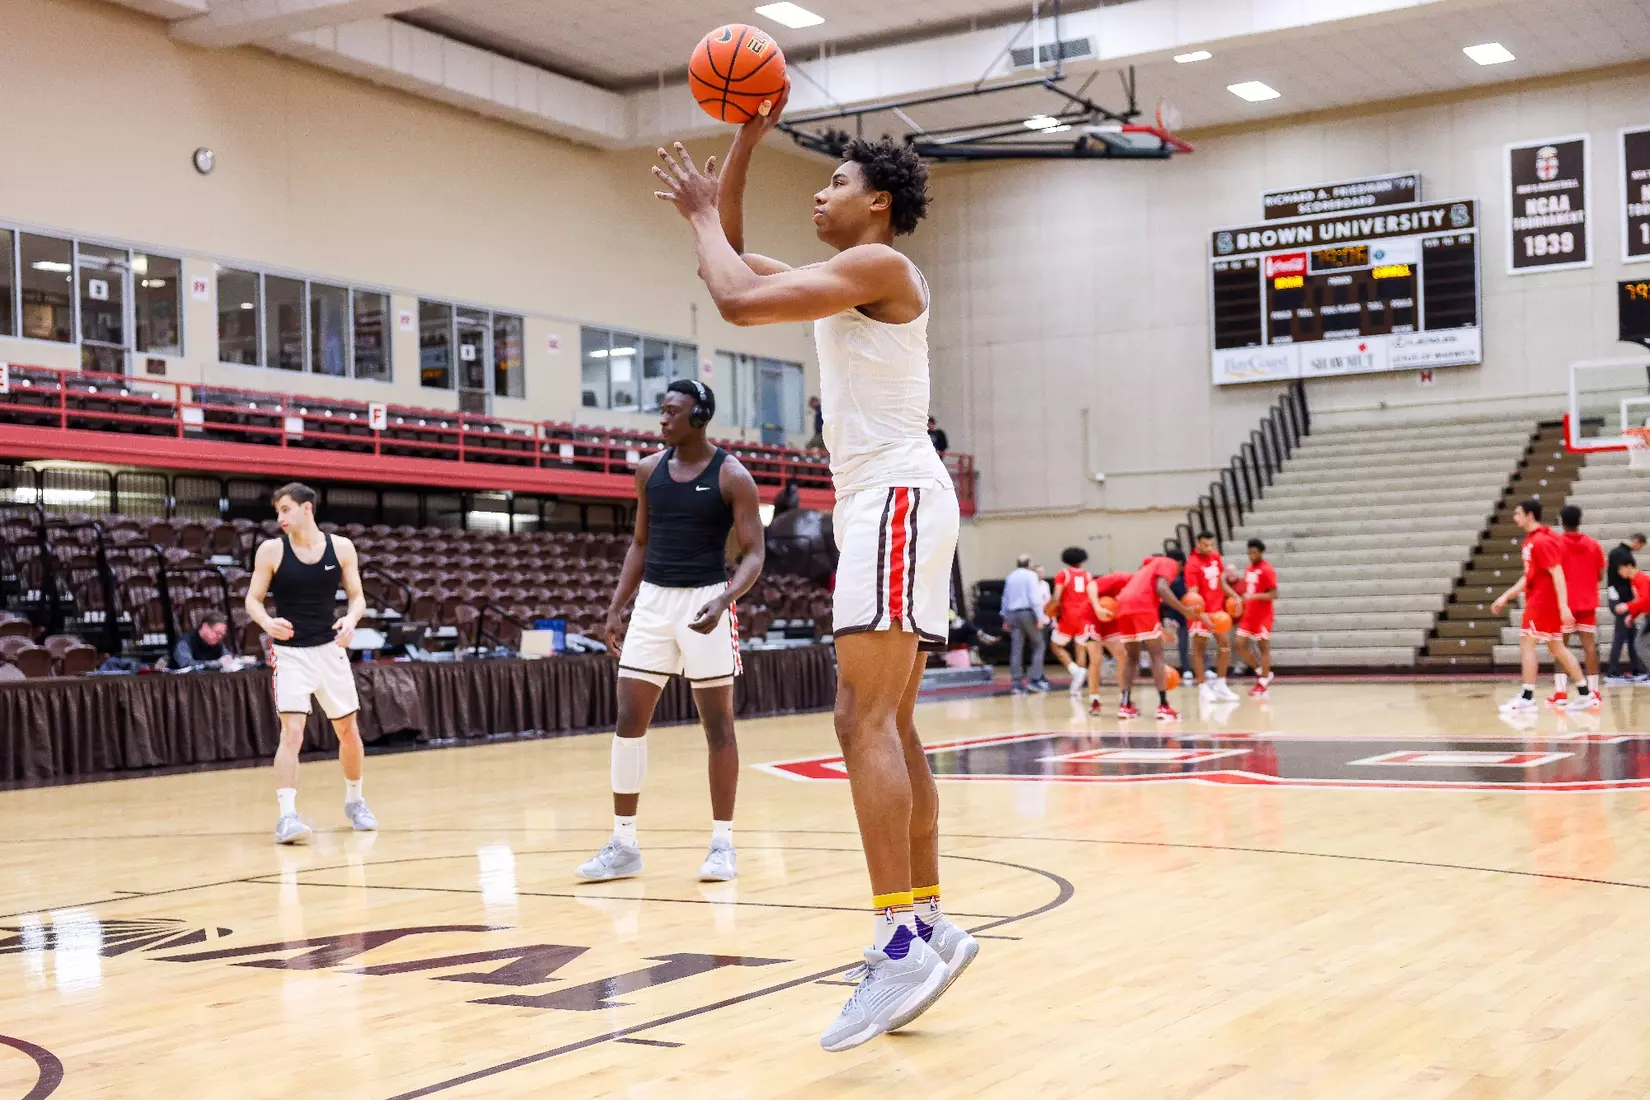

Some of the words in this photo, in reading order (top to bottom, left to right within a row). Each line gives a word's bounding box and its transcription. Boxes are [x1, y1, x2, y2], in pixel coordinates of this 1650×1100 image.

[1297, 194, 1376, 214] SCOREBOARD
[1525, 194, 1570, 216] NCAA
[1237, 225, 1313, 250] BROWN
[1319, 208, 1446, 240] UNIVERSITY
[1524, 231, 1575, 257] 1939
[373, 408, 382, 424] F
